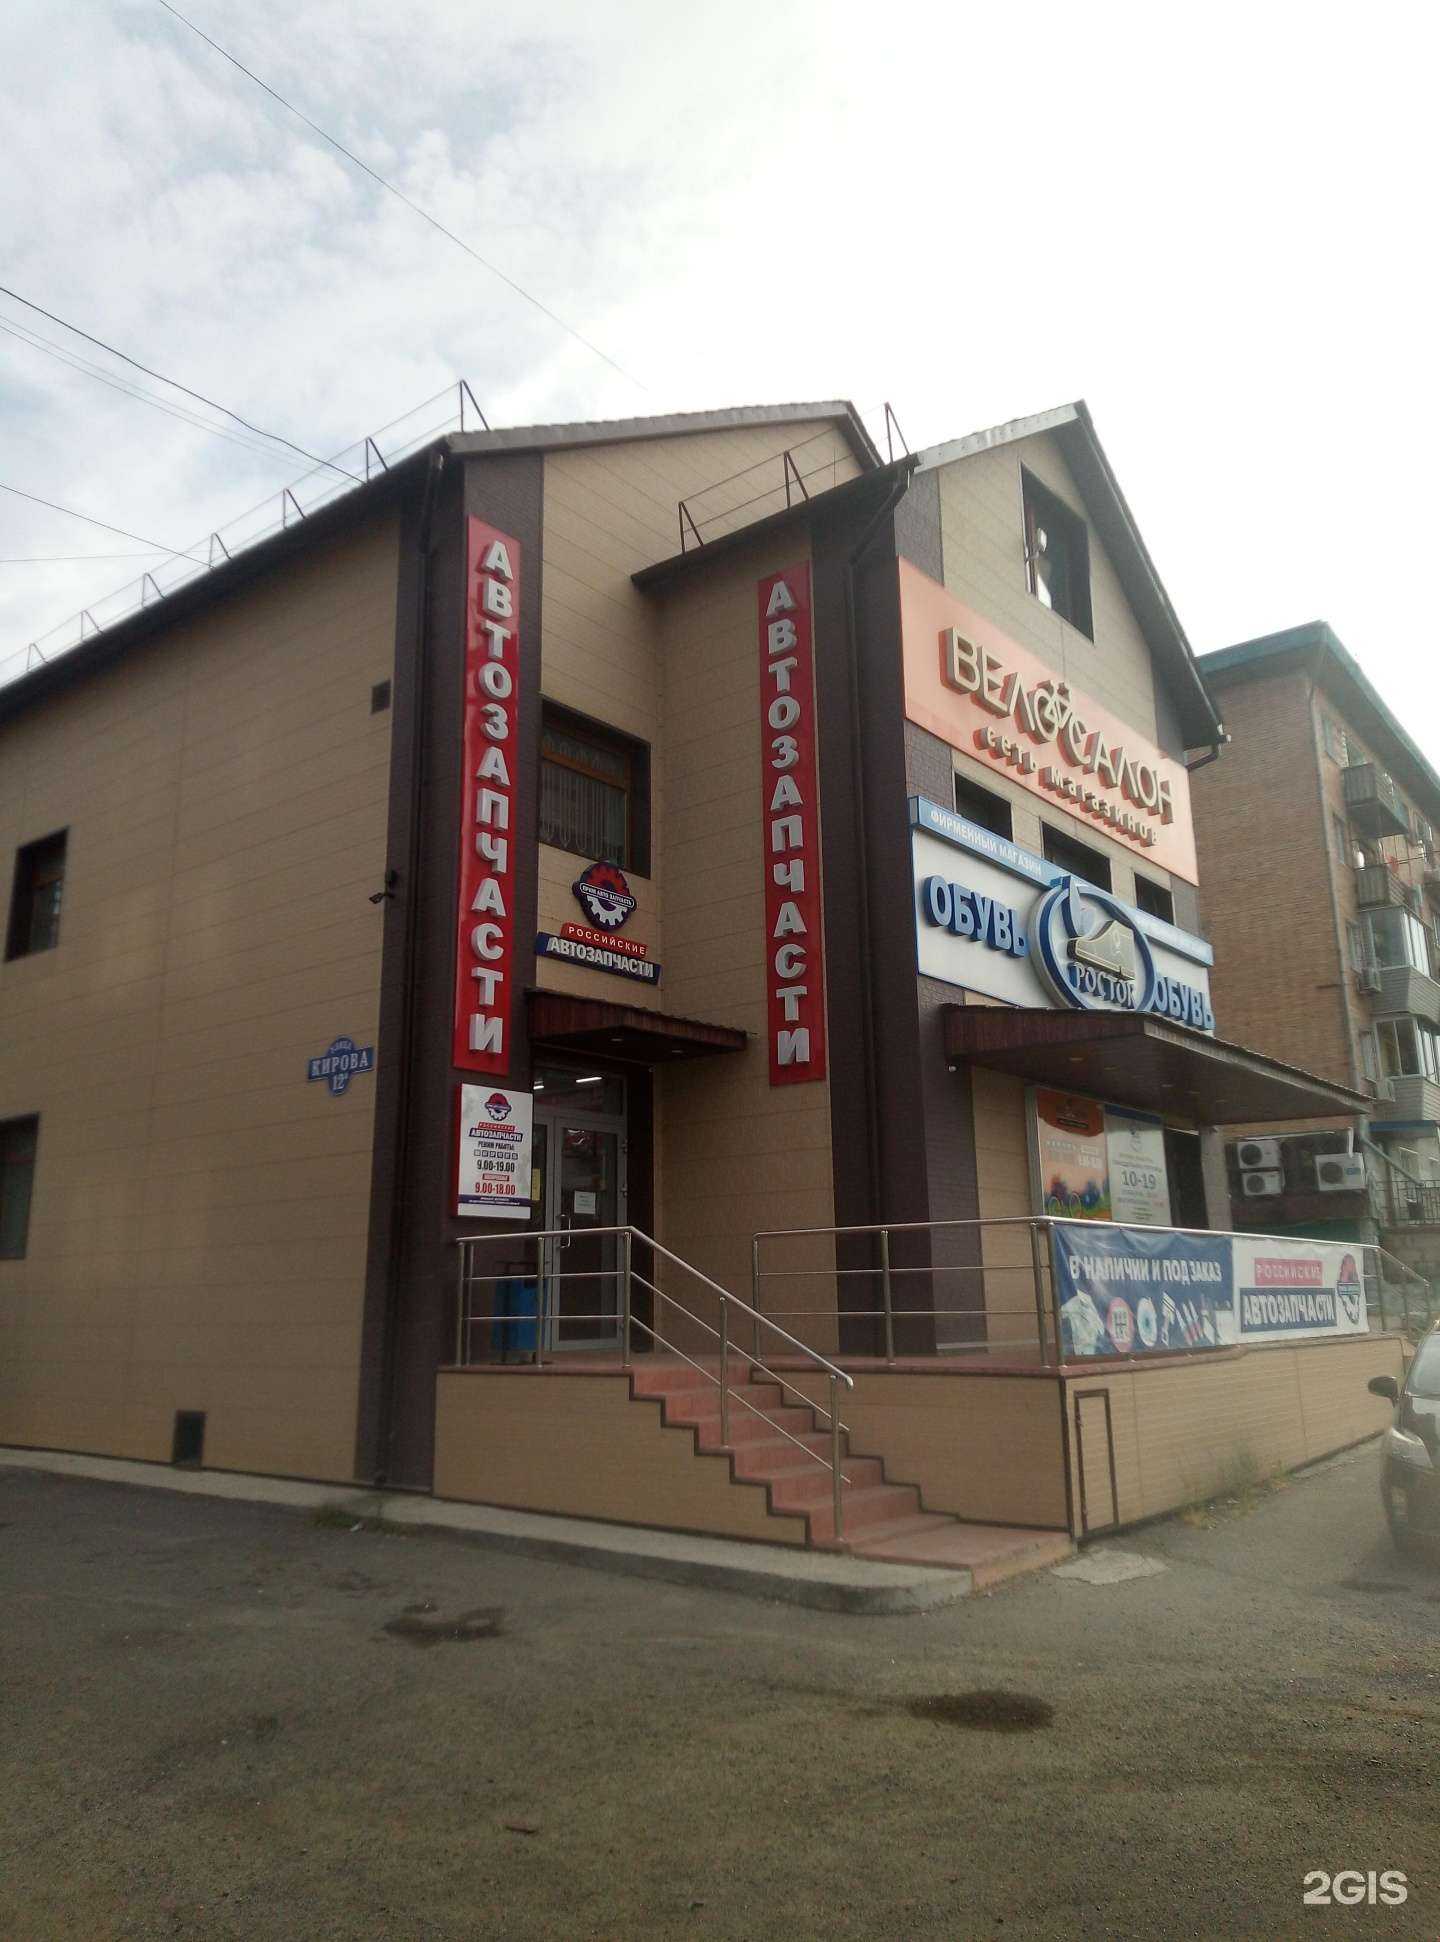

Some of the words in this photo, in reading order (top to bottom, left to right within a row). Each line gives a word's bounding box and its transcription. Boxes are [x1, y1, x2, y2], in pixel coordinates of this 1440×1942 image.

[973, 726, 1036, 775] сеть
[468, 539, 514, 1054] АВТОЗАПЧАСТИ
[766, 580, 811, 1067] АВТОЗАПЧАСТИ
[999, 842, 1042, 876] МАГАЗИН
[924, 875, 1027, 957] ОБУВЬ
[546, 937, 654, 978] АВТОЗАПЧАСТИ
[568, 926, 646, 955] РОССИЙСКИЕ
[1068, 961, 1136, 1010] РОСТОК
[1152, 975, 1216, 1031] ОБУВЬ
[311, 1050, 369, 1077] КИРОВА
[1069, 1256, 1081, 1279] В
[1083, 1256, 1150, 1281] НАЛИЧИИ
[1151, 1258, 1161, 1281] И
[1162, 1259, 1191, 1286] ПОД
[1190, 1261, 1222, 1282] ЗАКАЗ
[1243, 1294, 1335, 1326] АВТОЗАПЧАСТИ
